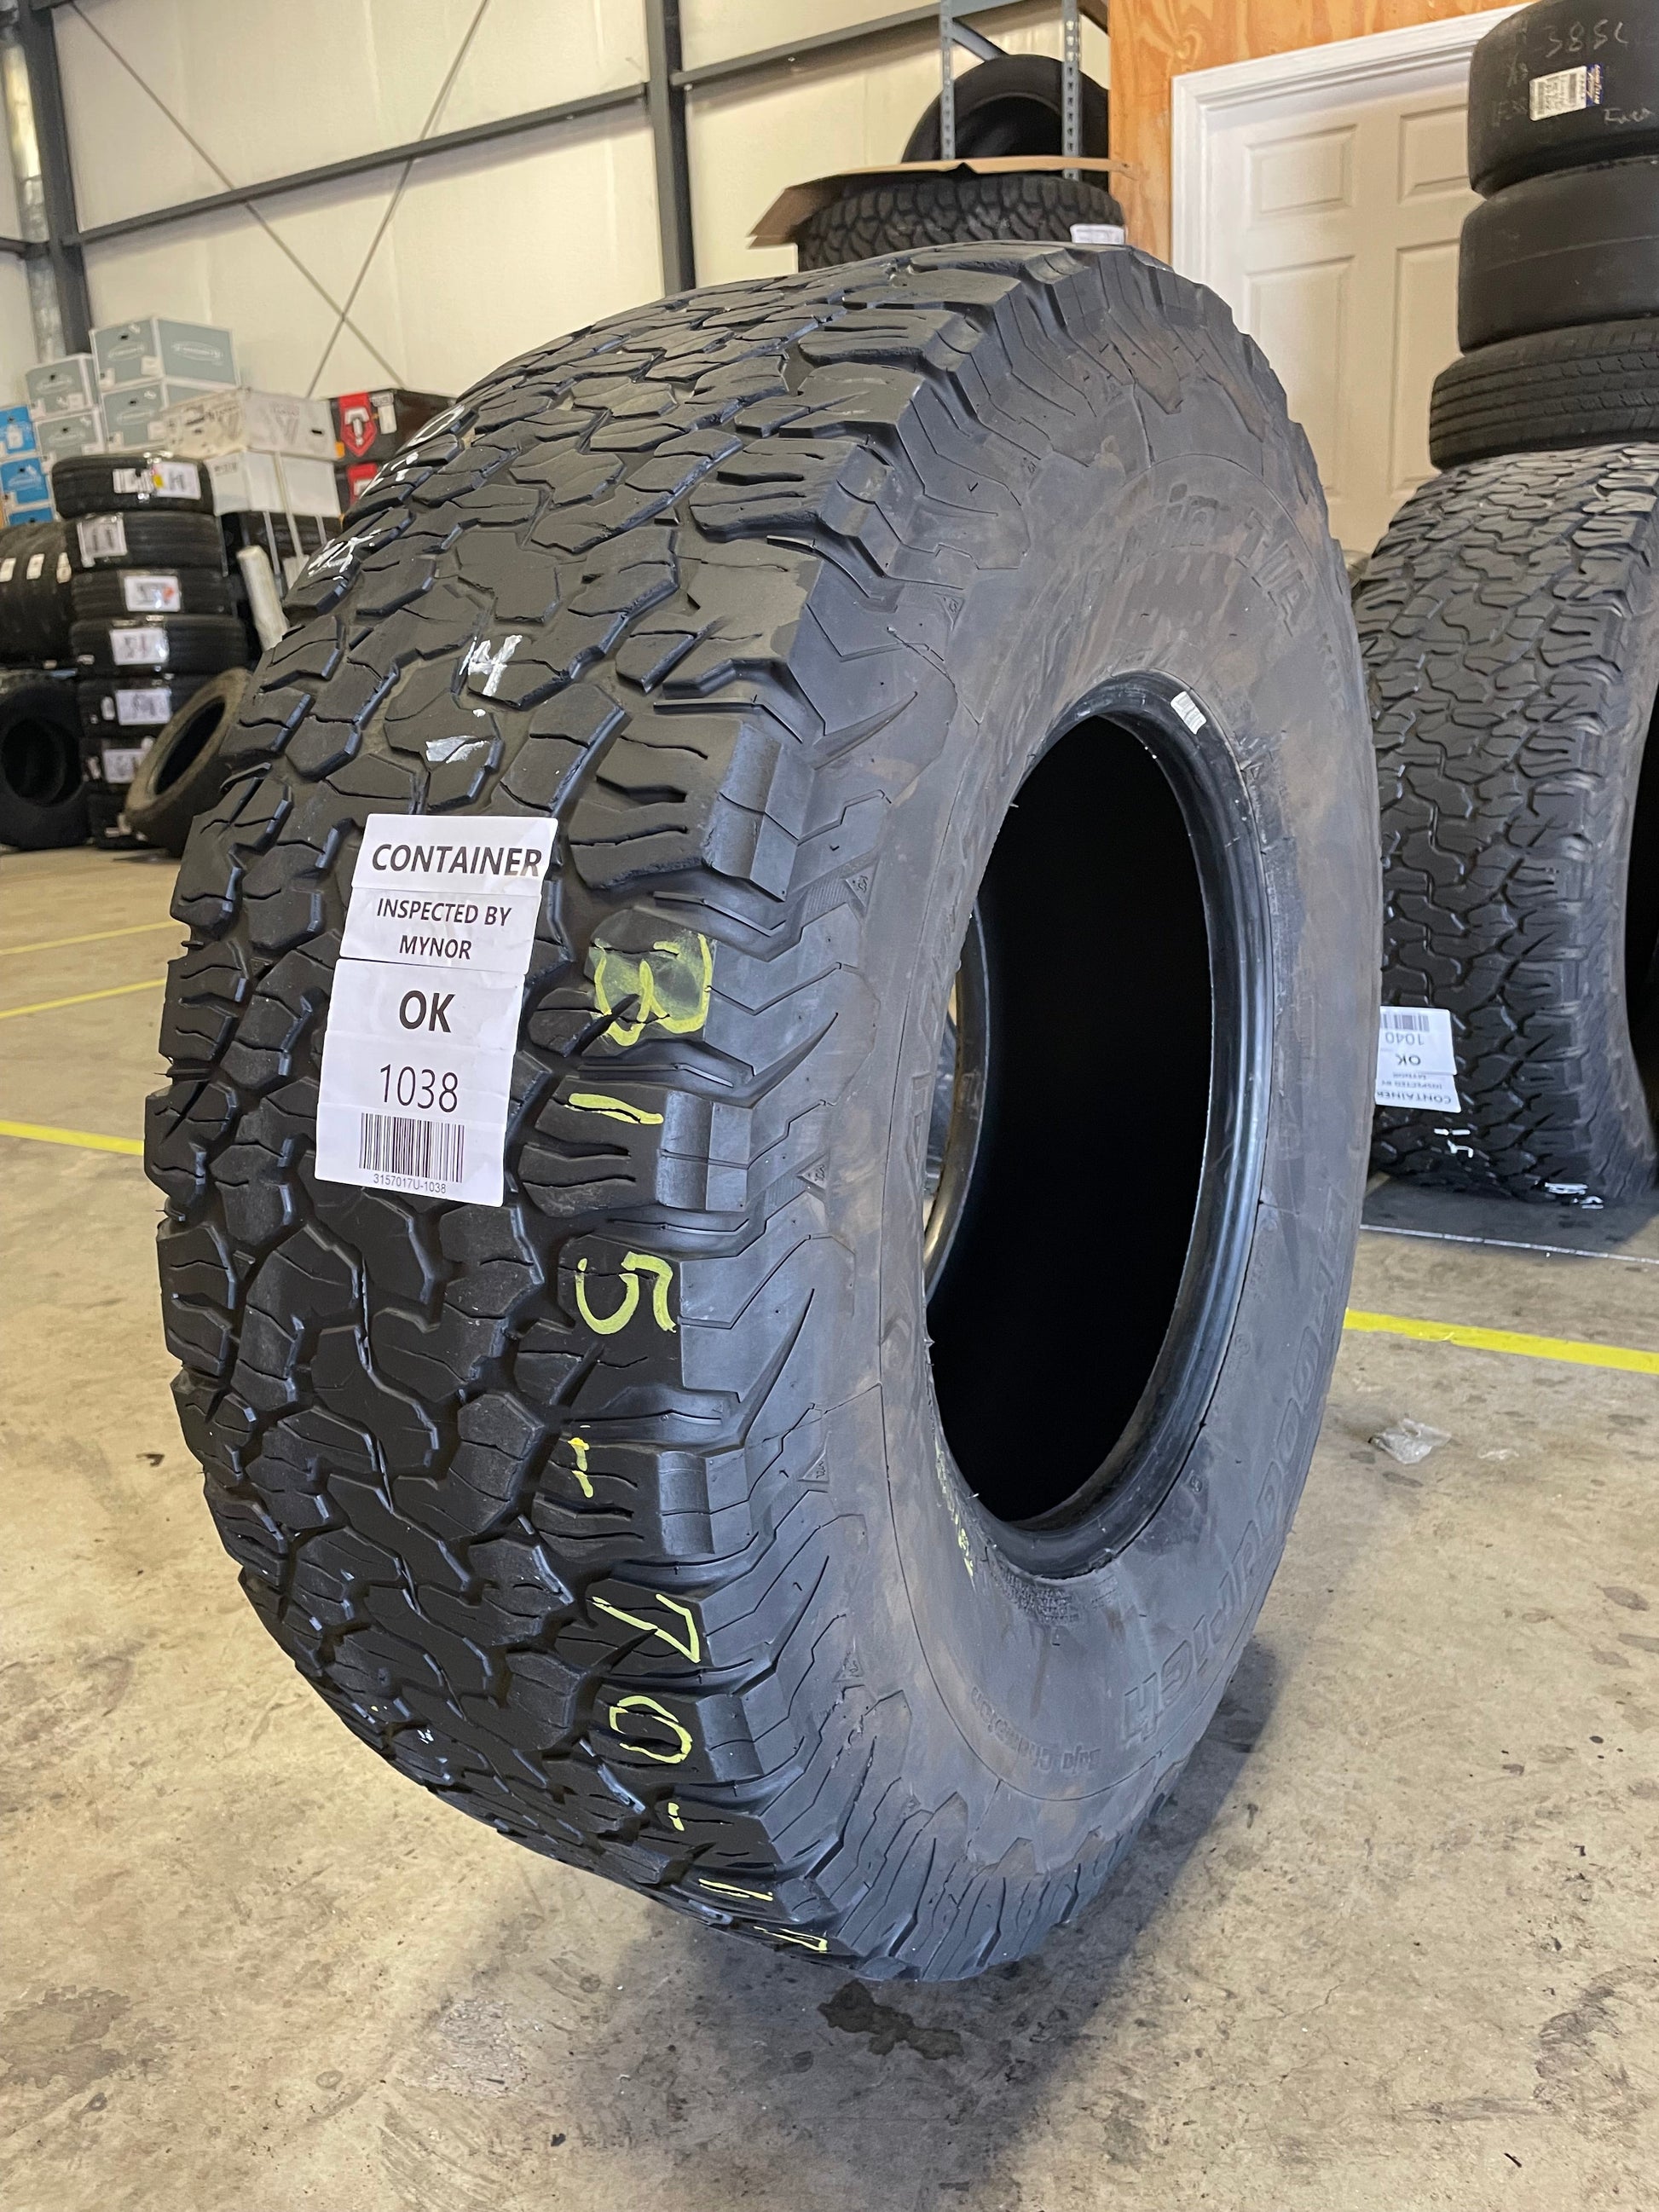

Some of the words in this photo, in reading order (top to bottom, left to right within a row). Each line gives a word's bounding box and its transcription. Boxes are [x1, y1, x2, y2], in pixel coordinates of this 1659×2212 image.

[372, 843, 543, 878] CONTAINER
[376, 898, 479, 925] INSPECTED
[483, 906, 512, 927] BY
[399, 935, 472, 960] MYNOR
[398, 989, 456, 1033] OK
[1384, 1031, 1425, 1046] 1040
[1395, 1054, 1422, 1066] OK
[379, 1063, 459, 1113] 1038
[1376, 1091, 1452, 1105] CONTAINER
[373, 1173, 447, 1195] 3157017U-1038
